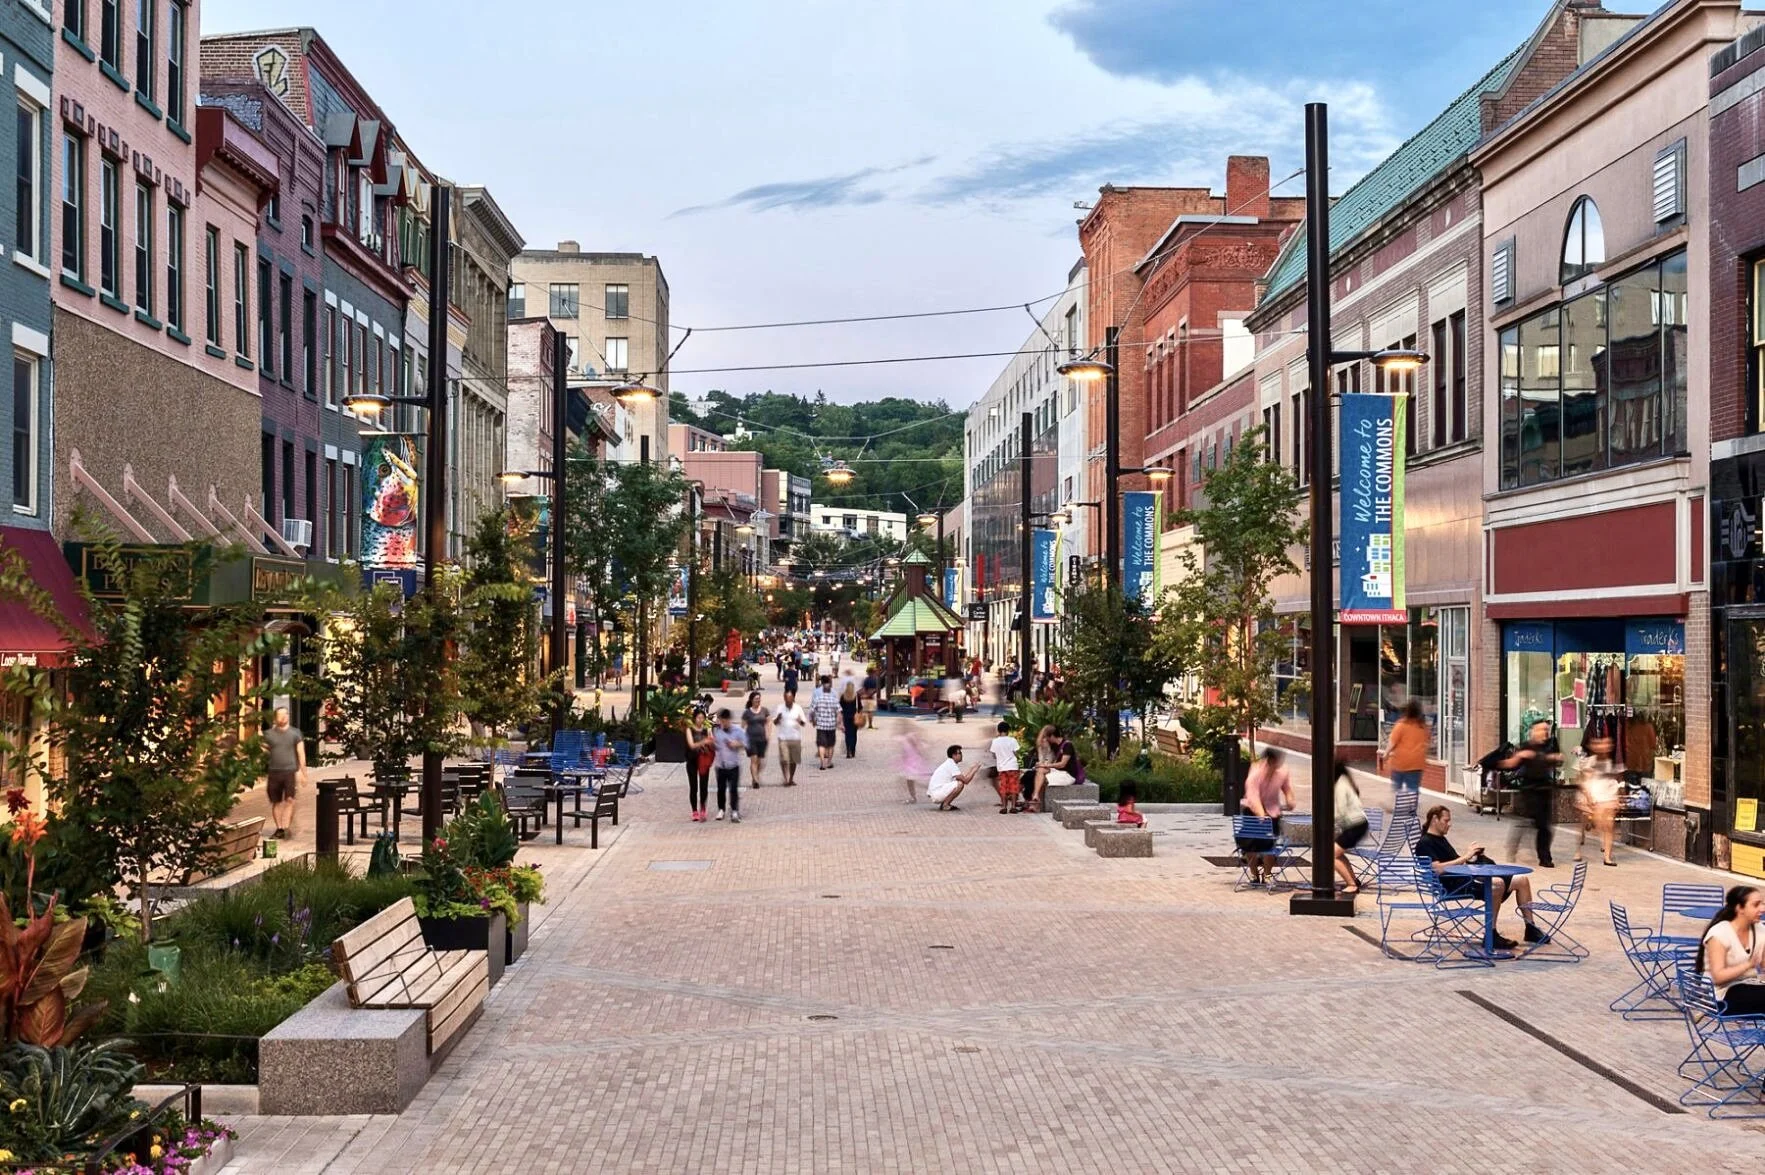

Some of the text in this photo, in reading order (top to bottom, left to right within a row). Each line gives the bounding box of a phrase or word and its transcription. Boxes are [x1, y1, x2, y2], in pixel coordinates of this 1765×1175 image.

[1352, 418, 1372, 522] Welcome to
[1375, 418, 1393, 523] THE COMMONS
[1131, 506, 1144, 566] Welcome to
[1144, 505, 1155, 566] THE COMMONS
[1343, 613, 1404, 621] DOWNTOWN ITHACA
